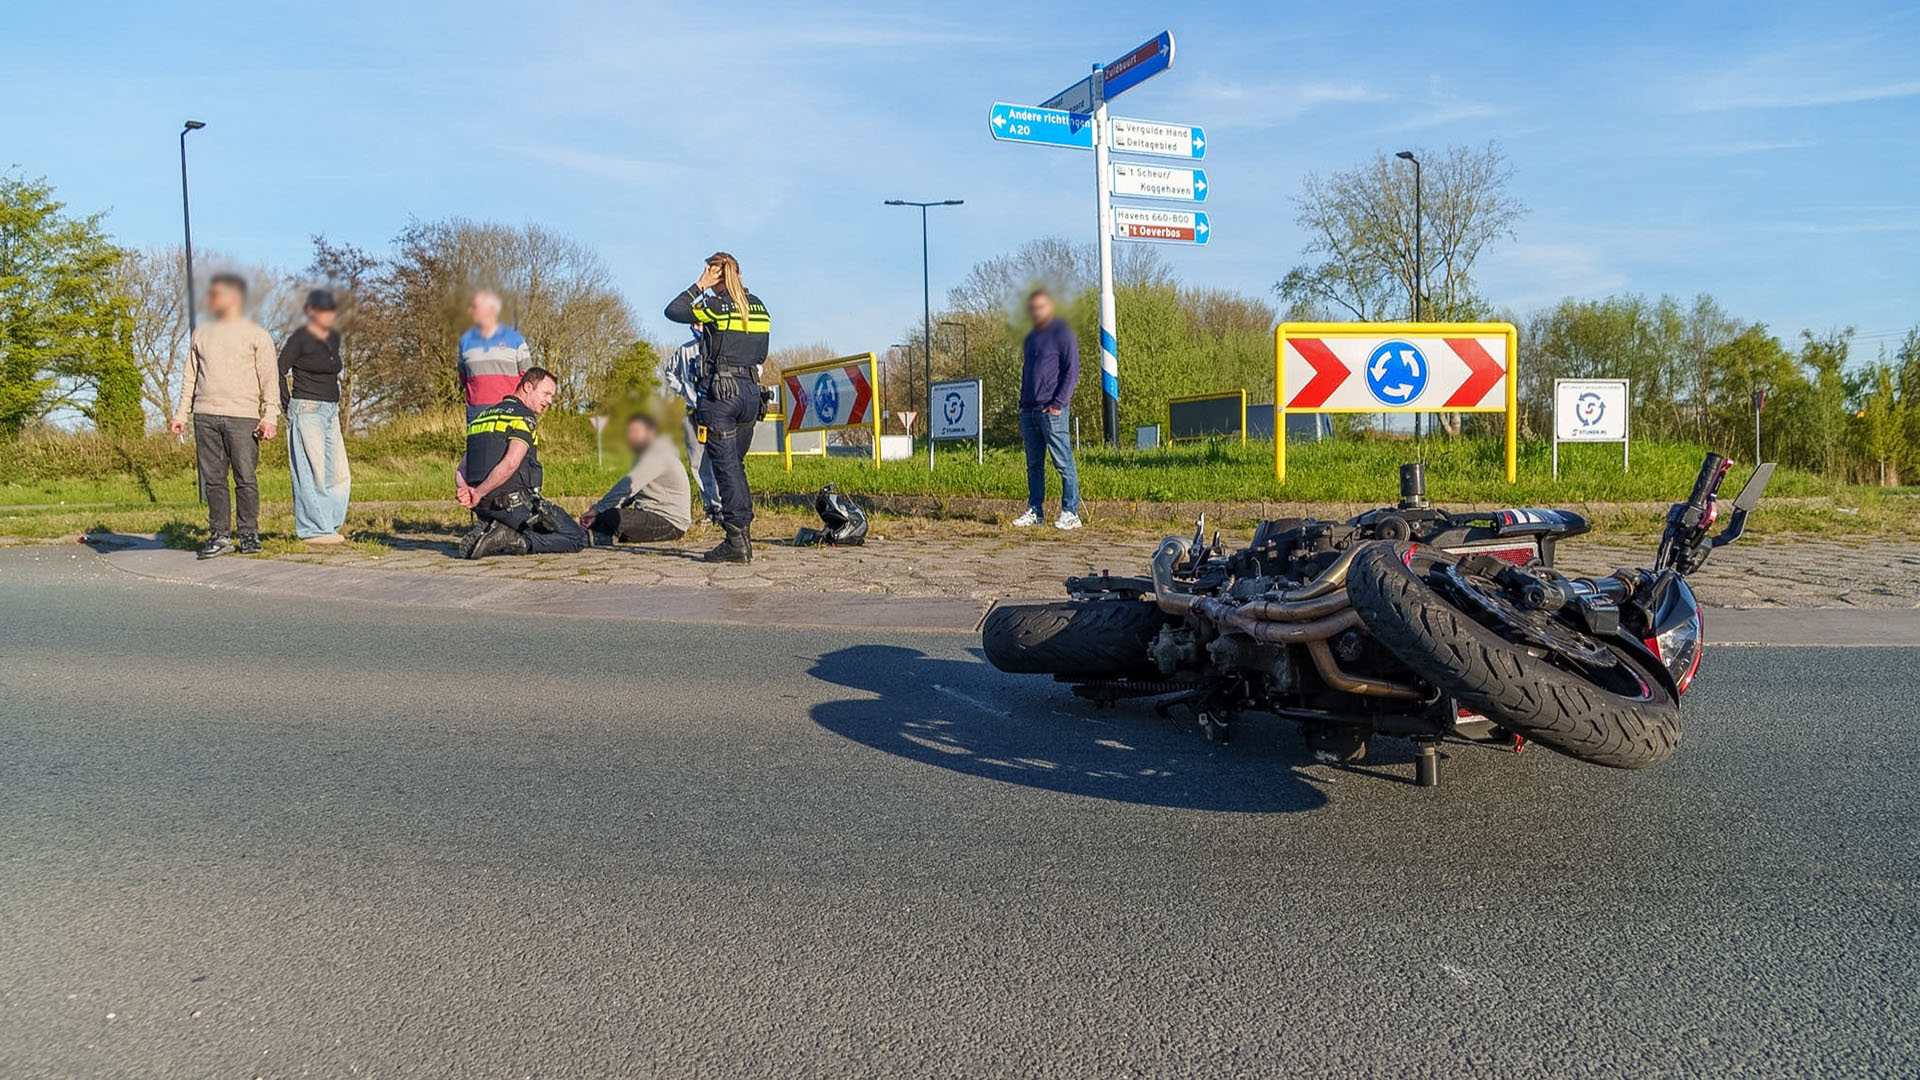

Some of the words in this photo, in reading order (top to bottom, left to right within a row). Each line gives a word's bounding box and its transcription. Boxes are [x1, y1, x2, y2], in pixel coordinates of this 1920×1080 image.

[1008, 108, 1041, 122] Andere
[1044, 113, 1091, 128] richtingen
[1009, 124, 1030, 135] A20
[1126, 123, 1163, 135] Vergulde
[1166, 127, 1188, 138] Hand
[1127, 137, 1177, 151] Deltagebied
[1137, 168, 1171, 179] Scheur/
[1140, 183, 1191, 195] Koggehaven
[1118, 210, 1149, 221] Havens
[1152, 213, 1189, 224] 660-800
[1130, 225, 1137, 236] 't
[1139, 226, 1181, 238] Oeverbos
